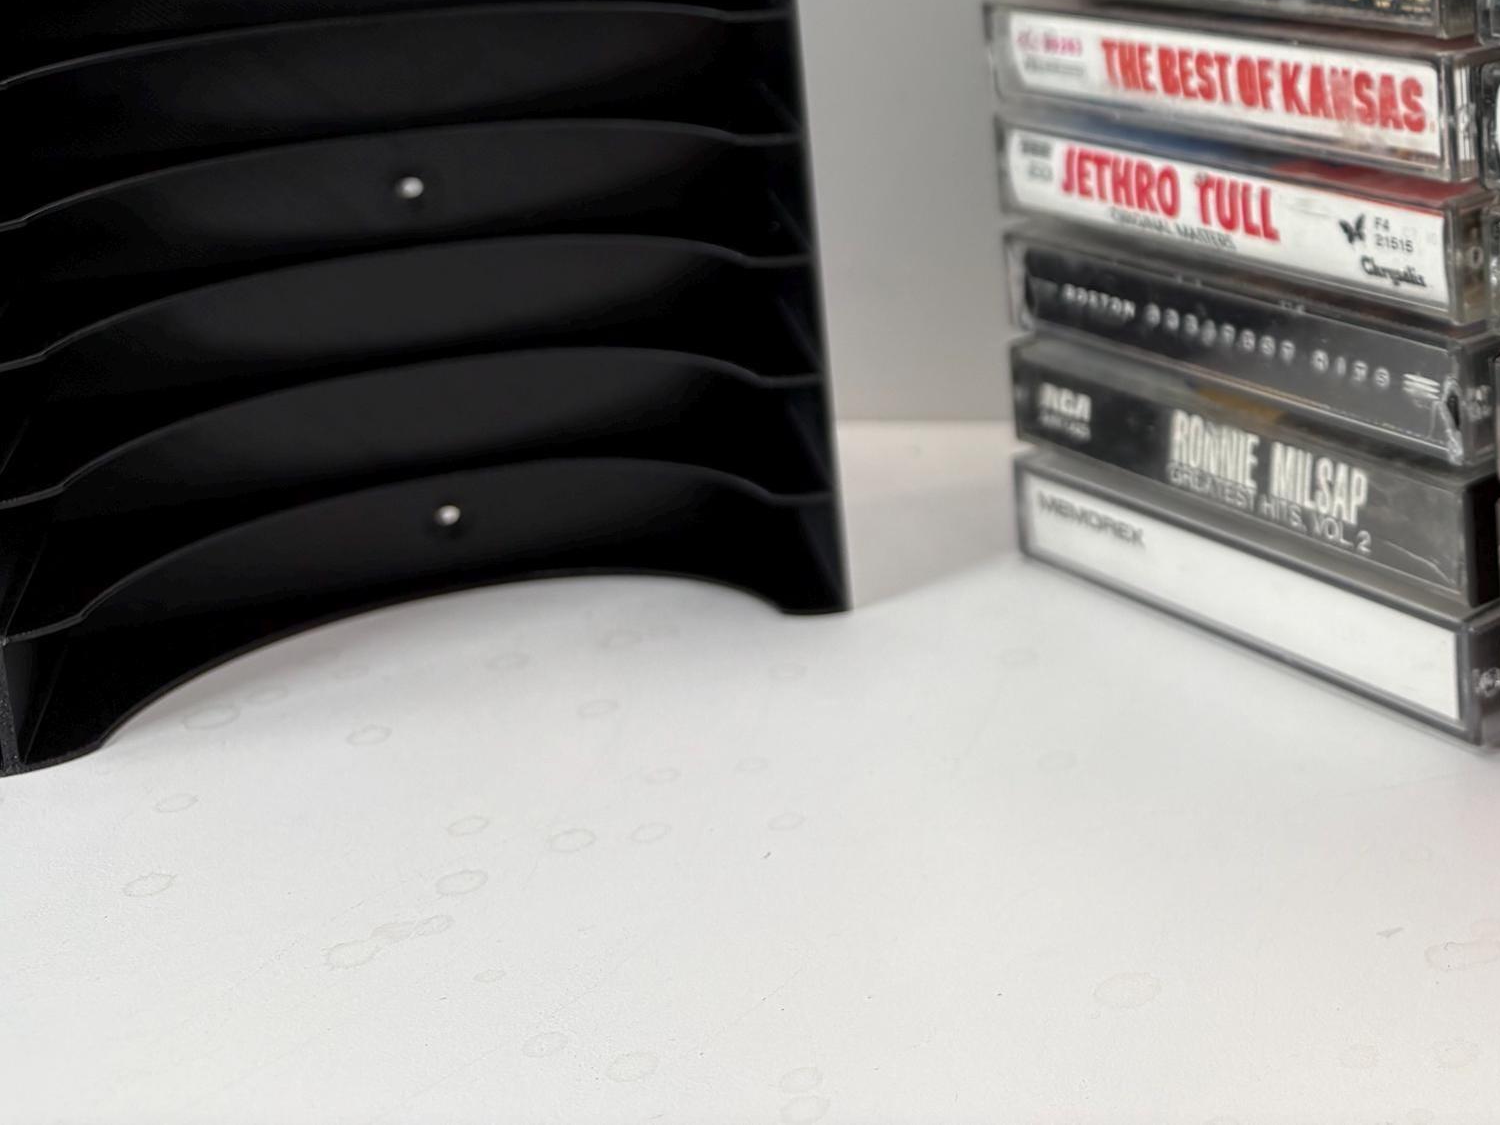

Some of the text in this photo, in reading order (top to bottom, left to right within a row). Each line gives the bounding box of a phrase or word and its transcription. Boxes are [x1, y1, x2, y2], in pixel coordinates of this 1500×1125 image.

[1101, 38, 1157, 93] THE
[1157, 47, 1233, 107] BEST
[1235, 56, 1277, 110] OF
[1281, 61, 1427, 134] KANSAS
[1061, 145, 1280, 243] JETHRO TULL
[1375, 234, 1415, 254] 21515
[1167, 460, 1258, 510] GREATEST
[1355, 530, 1372, 554] 2
[1170, 409, 1369, 525] RONNIE MILSAP
[1036, 490, 1147, 550] MEMOREX
